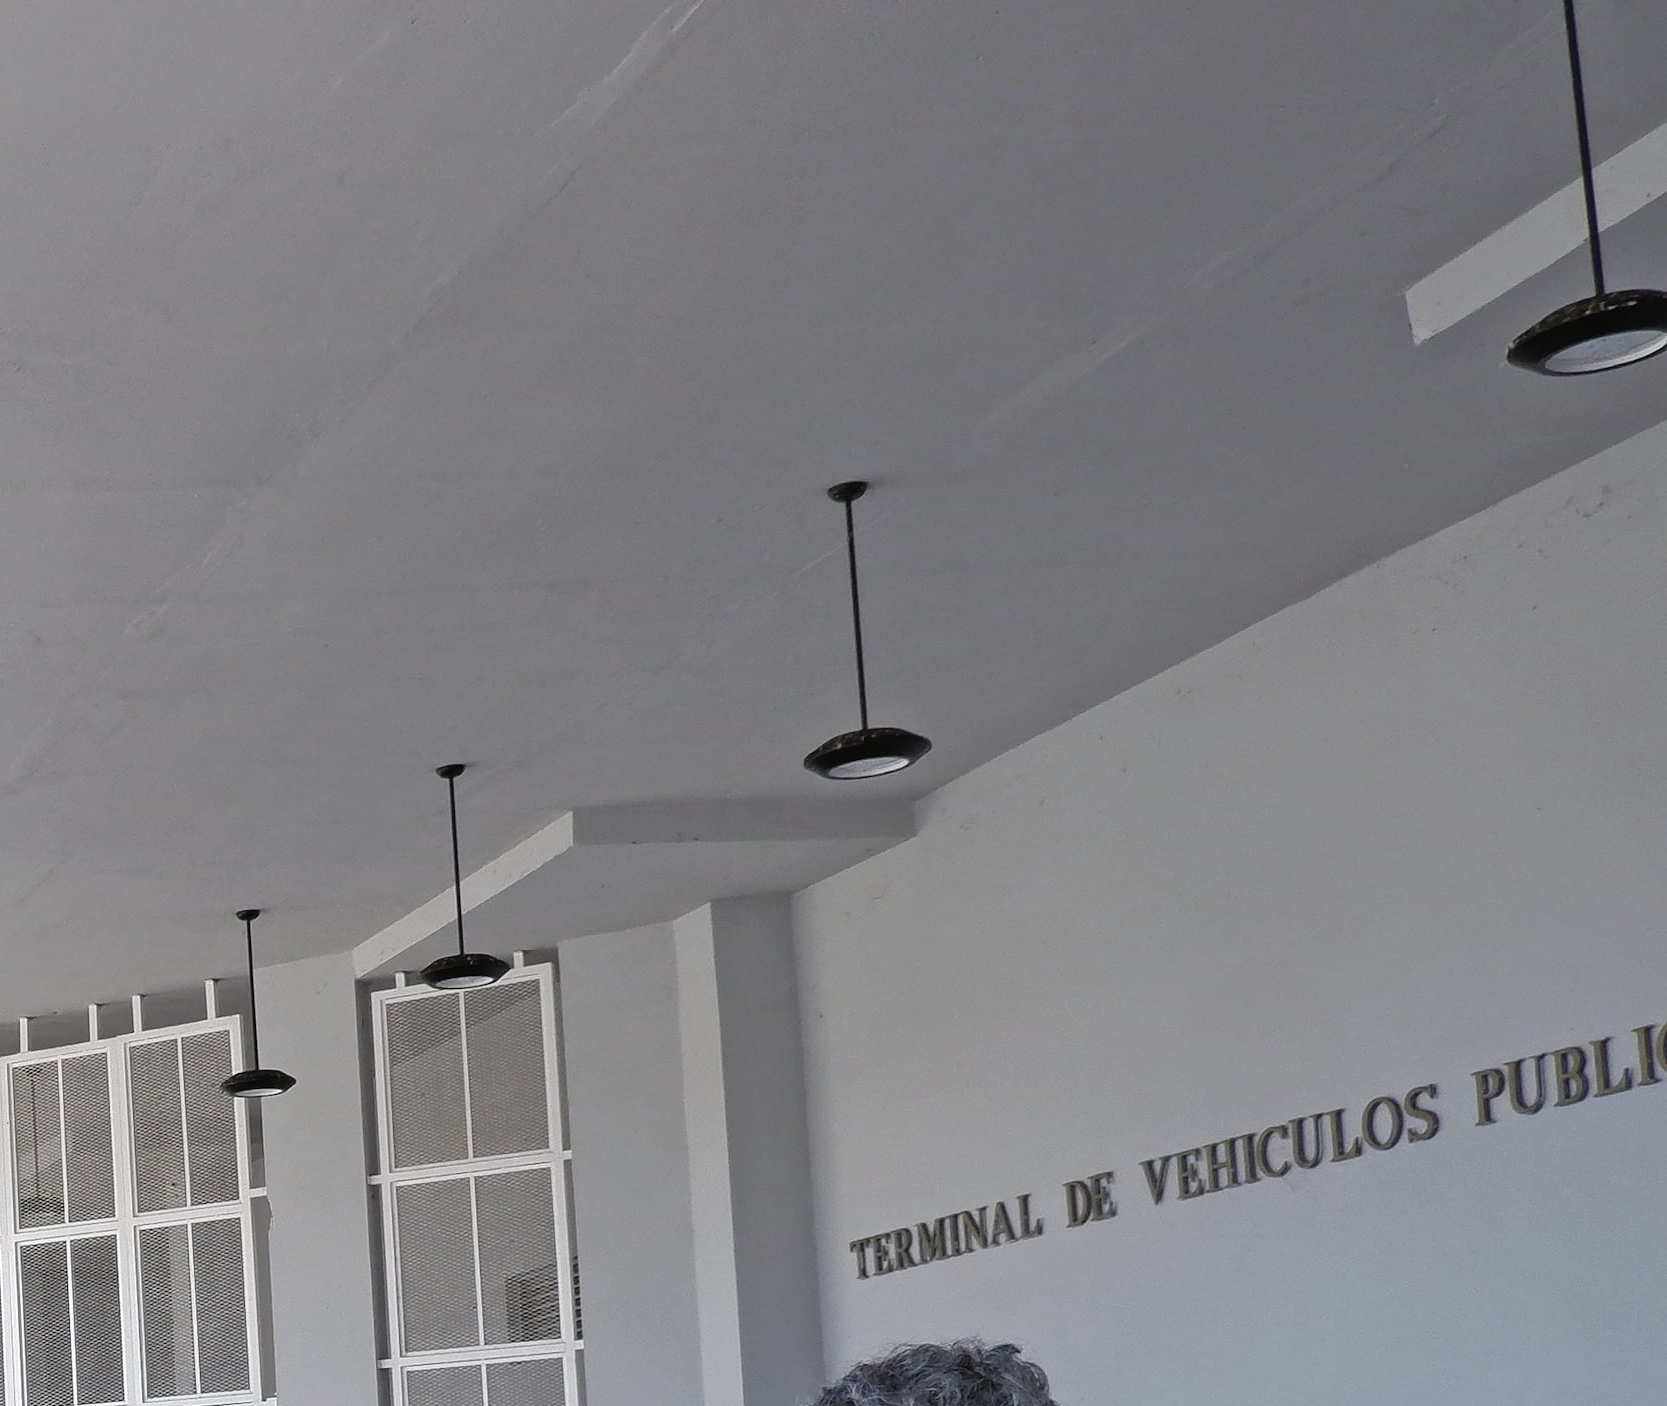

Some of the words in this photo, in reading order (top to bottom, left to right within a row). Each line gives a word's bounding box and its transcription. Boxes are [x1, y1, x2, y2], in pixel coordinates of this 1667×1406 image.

[850, 1193, 1044, 1280] TERMINAL
[1062, 1171, 1118, 1229] DE
[1139, 1083, 1441, 1206] VEHICULOS
[1471, 1021, 1667, 1128] PUBLI
